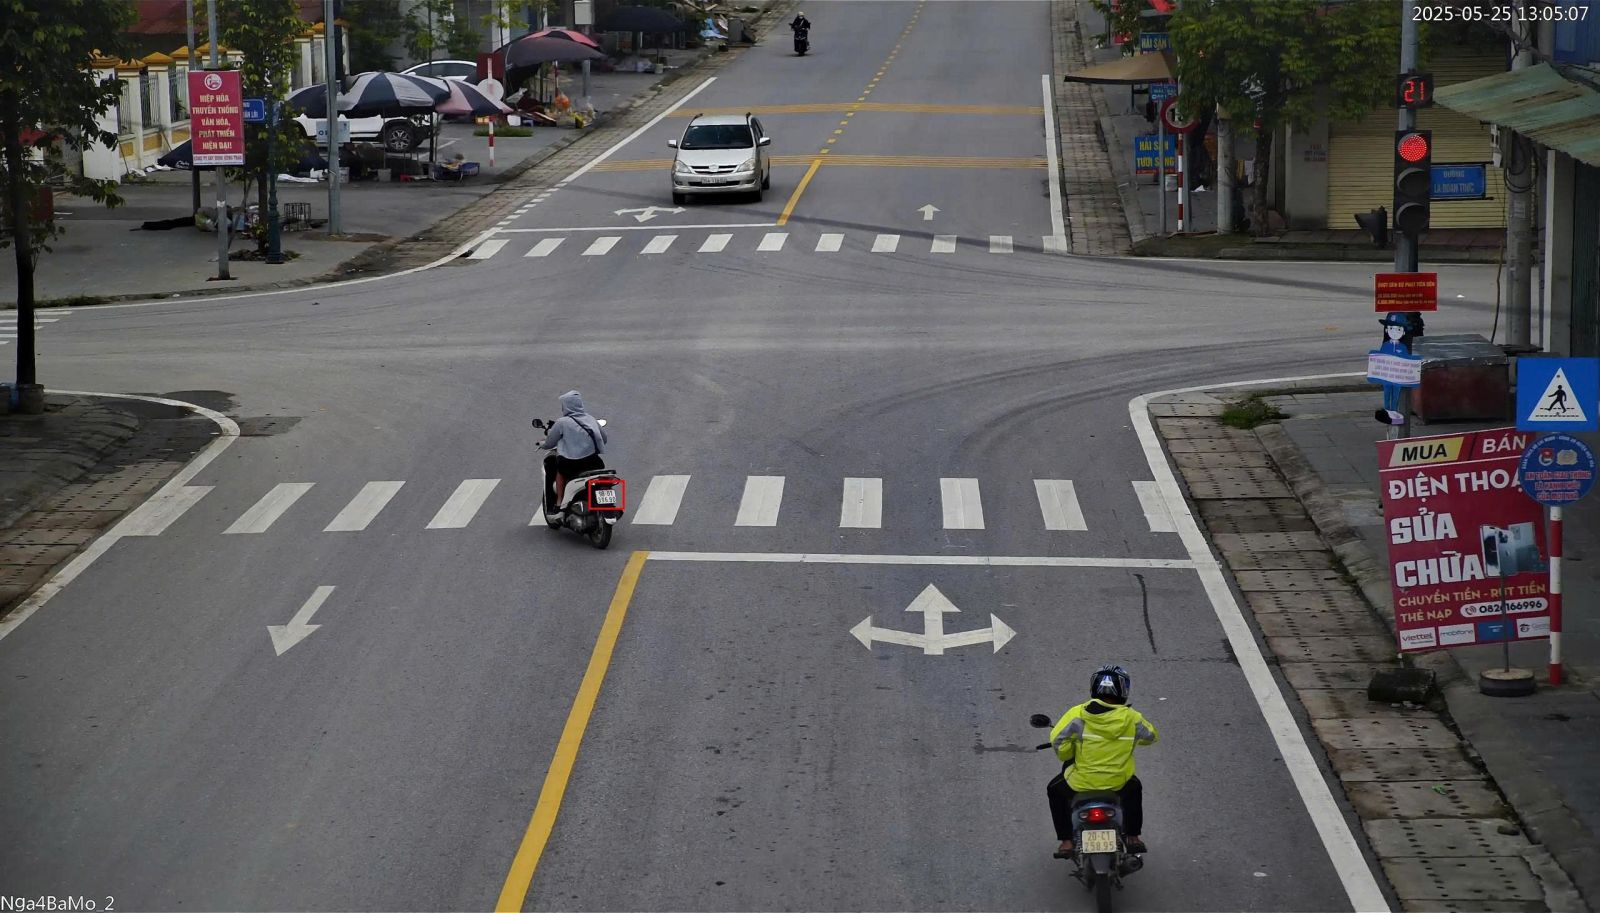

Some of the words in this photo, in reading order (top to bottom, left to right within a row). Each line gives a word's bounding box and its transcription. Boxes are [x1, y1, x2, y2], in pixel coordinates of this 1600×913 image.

[1403, 79, 1425, 103] 21
[1402, 443, 1448, 462] MUA
[1482, 434, 1526, 454] BÁN
[1389, 471, 1449, 503] ĐIỆN
[1390, 506, 1458, 545] SỬA
[1427, 608, 1453, 622] NẠP
[1402, 631, 1434, 642] viettel
